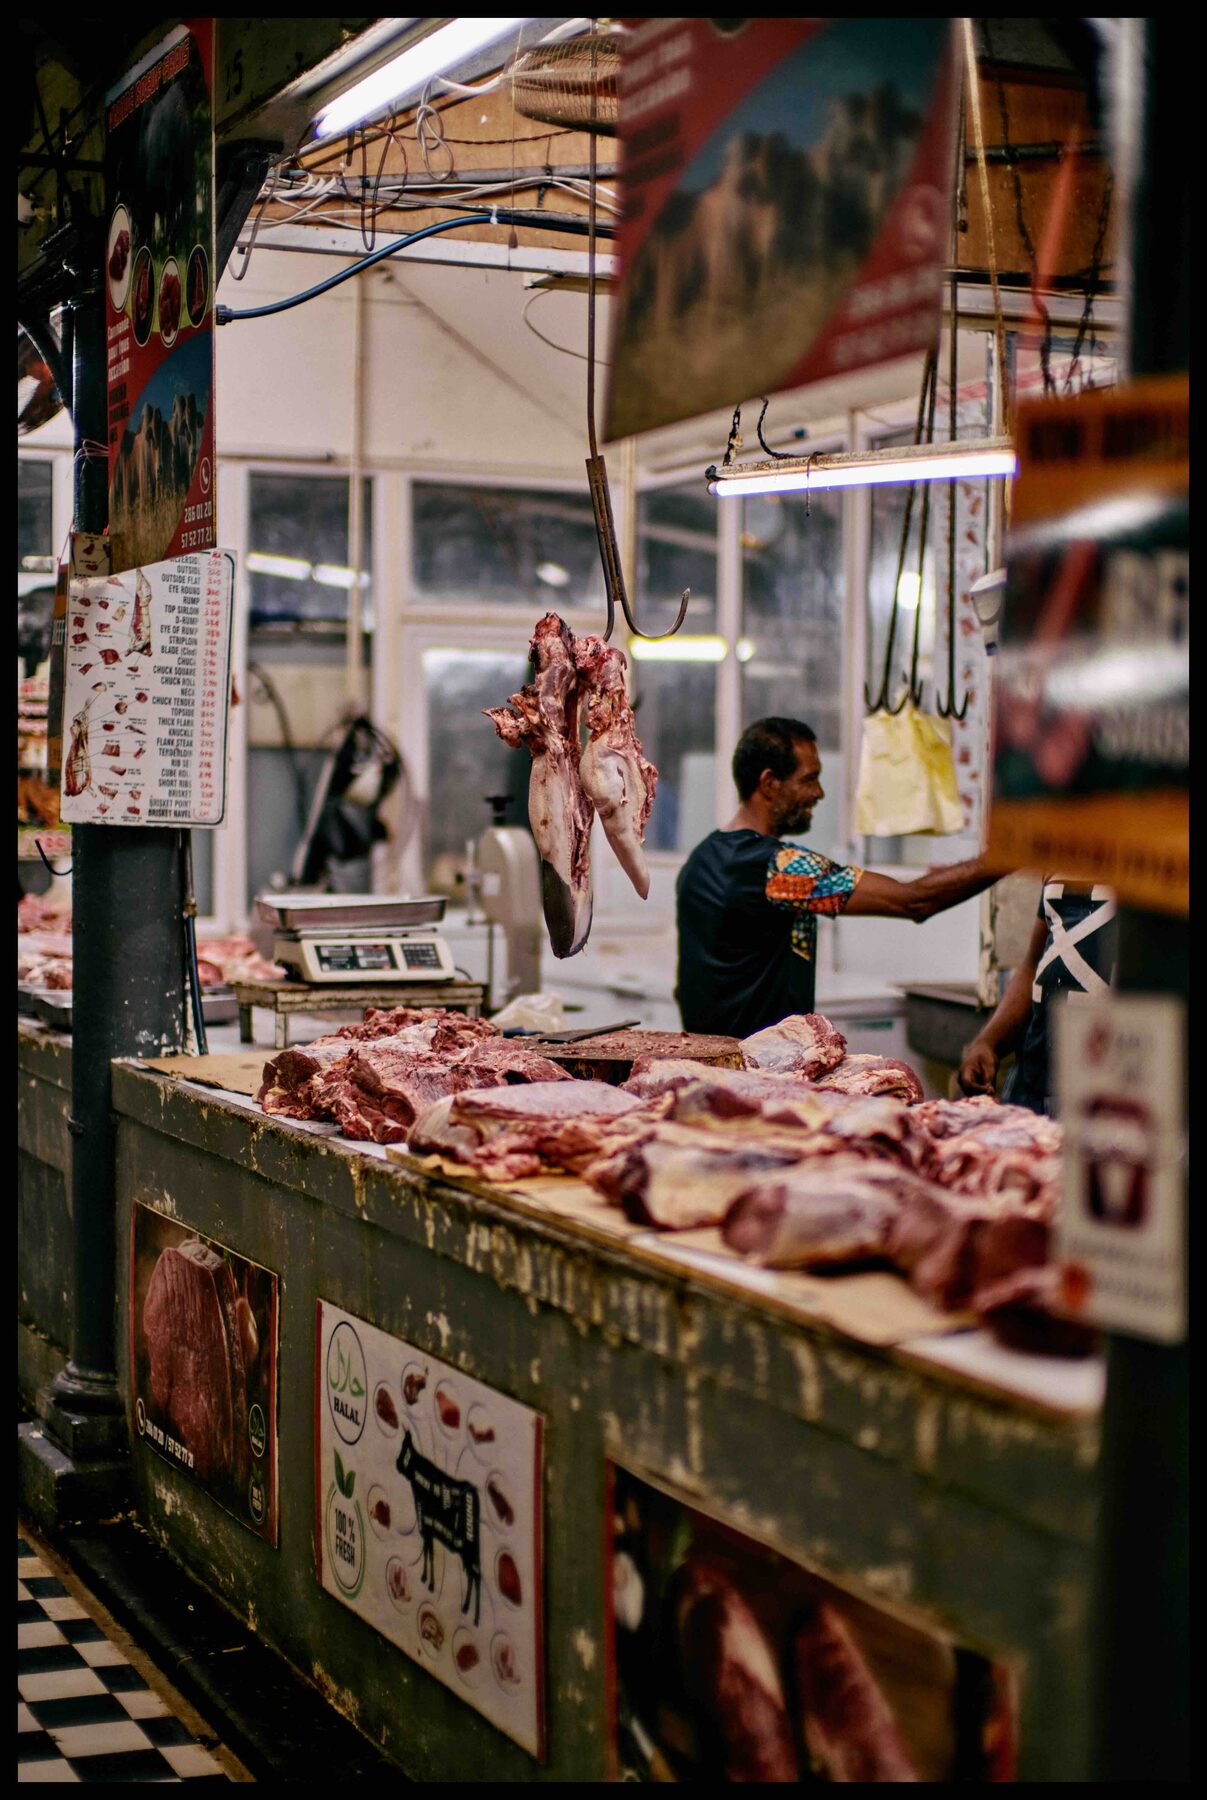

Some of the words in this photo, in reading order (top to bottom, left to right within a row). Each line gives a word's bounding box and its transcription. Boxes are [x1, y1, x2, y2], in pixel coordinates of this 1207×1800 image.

[184, 505, 195, 523] 286
[196, 503, 203, 520] 01
[204, 500, 212, 518] 20
[189, 530, 196, 546] 52
[197, 528, 204, 545] 77
[205, 526, 212, 542] 21
[161, 573, 186, 583] OUTSIDE
[168, 584, 179, 593] EYE
[183, 596, 200, 605] RUMP
[165, 604, 176, 614] TOP
[160, 624, 171, 633] EYE
[172, 626, 180, 634] OF
[169, 635, 198, 645] STRIPLOIN
[161, 645, 179, 655] BLADE
[153, 665, 172, 674] CHUCK
[174, 667, 196, 677] SQUARE
[161, 676, 181, 685] CHUCK
[152, 696, 172, 705] CHUCK
[171, 707, 195, 717] TOPSIDE
[158, 717, 175, 726] THICK
[157, 737, 174, 747] FLANK
[176, 738, 193, 747] STEAK
[161, 768, 177, 777] CUBE
[158, 778, 178, 787] SHORT
[168, 789, 192, 798] BRISKET
[148, 808, 172, 818] BRISKET
[173, 809, 191, 818] NAVEL
[334, 1396, 361, 1427] HALAL
[335, 1507, 347, 1537] 100
[348, 1517, 355, 1543] %
[335, 1534, 356, 1568] FRESH
